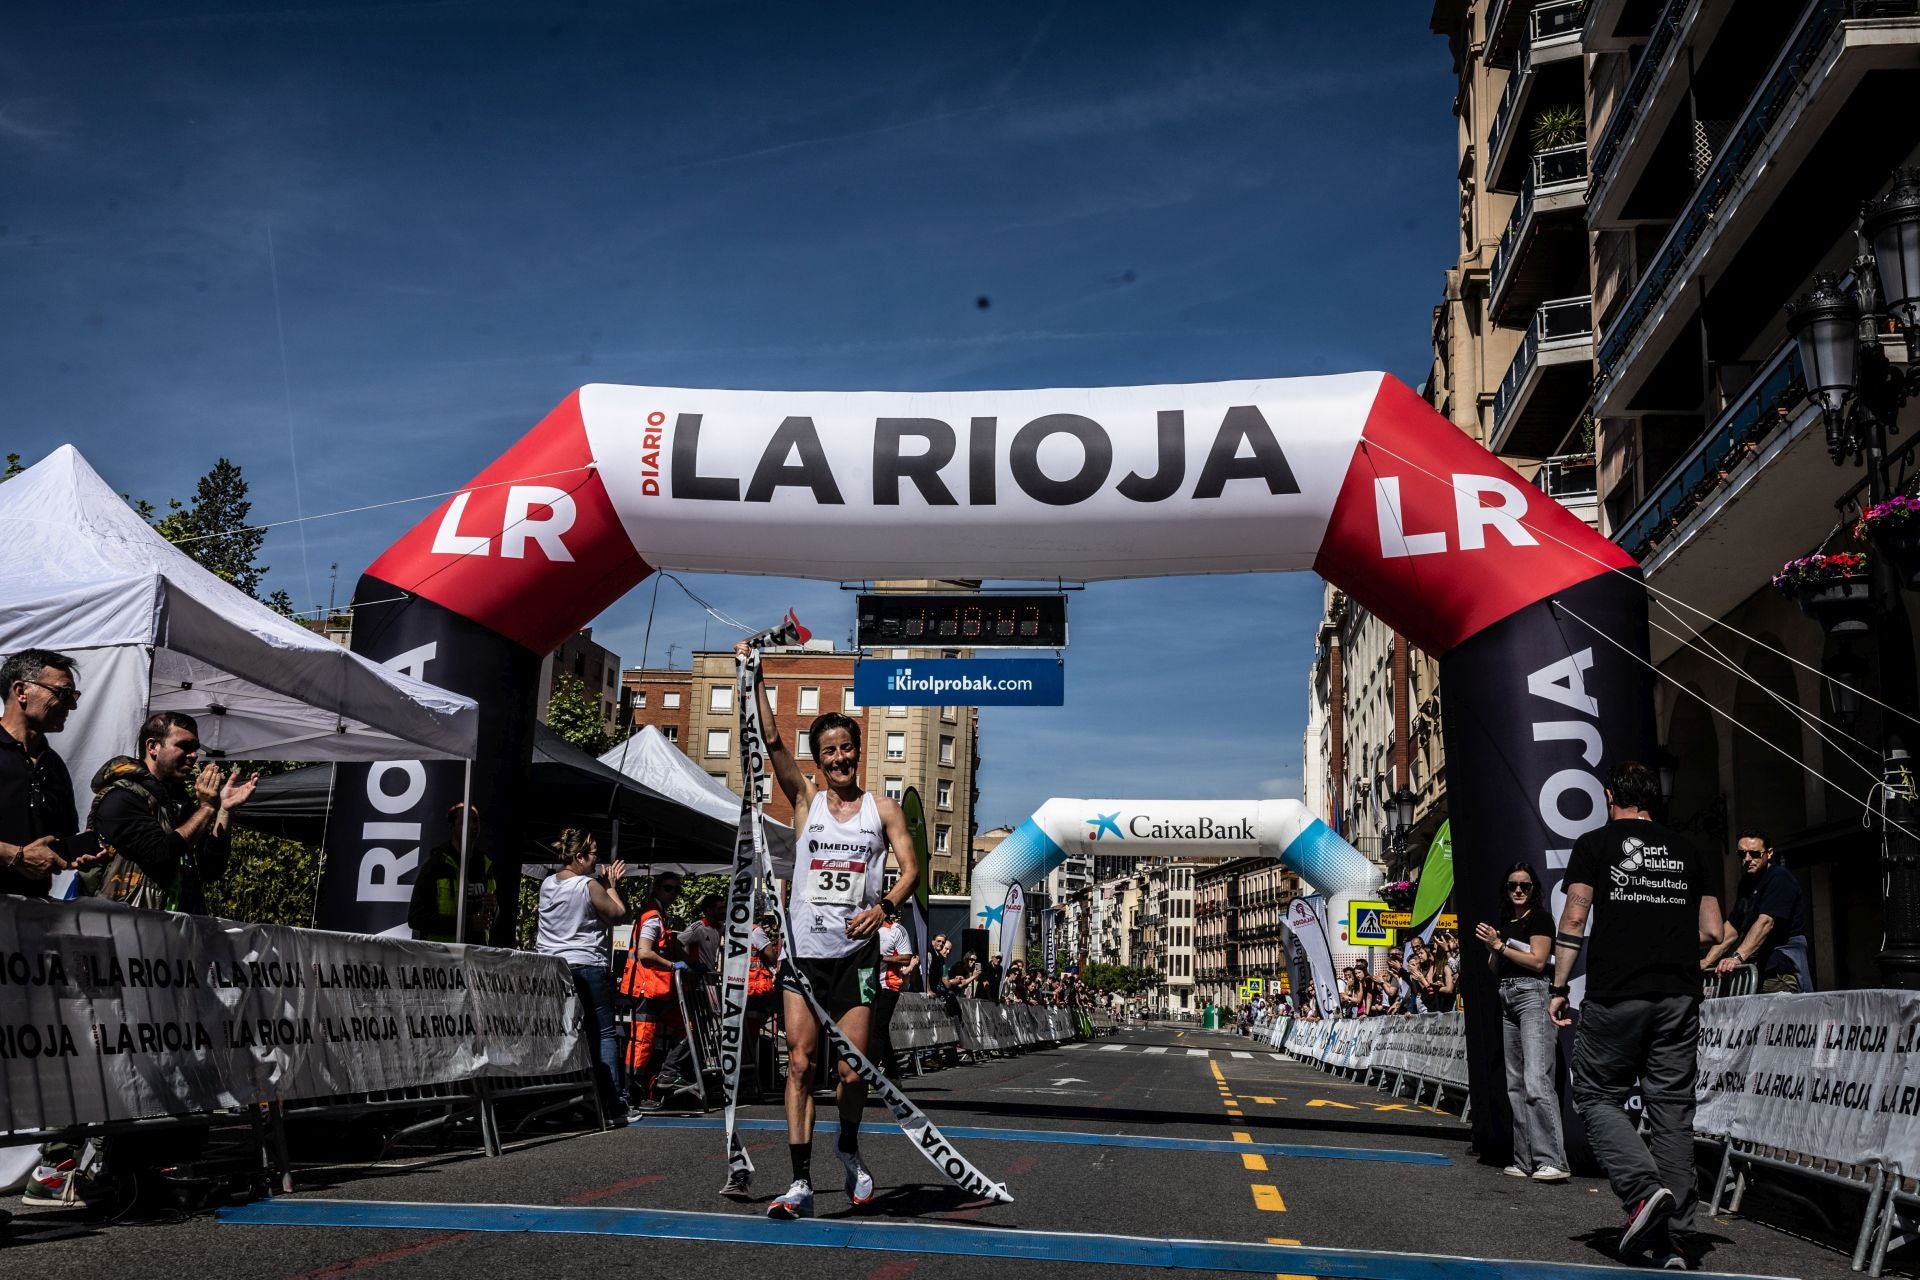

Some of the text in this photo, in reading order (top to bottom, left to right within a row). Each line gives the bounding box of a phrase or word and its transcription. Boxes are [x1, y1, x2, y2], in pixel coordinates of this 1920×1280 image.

[642, 411, 666, 496] DIARIO
[672, 405, 1302, 506] LA RIOJA
[431, 486, 577, 562] LR
[1374, 473, 1540, 558] LR
[896, 671, 1032, 694] Kirolprobak.com
[1129, 815, 1256, 840] CaixaBank
[820, 842, 873, 854] IMEDUSA
[818, 871, 851, 892] 35
[1630, 876, 1688, 890] TuResultado
[1614, 891, 1686, 904] Kirolprobak.com
[728, 876, 751, 959] RIOJA
[91, 955, 126, 987] LA
[128, 957, 200, 988] RIOJA
[214, 961, 248, 988] LA
[249, 961, 305, 988] RIOJA
[318, 963, 391, 990] LA RIOJA
[401, 966, 467, 990] LA RIOJA
[724, 983, 744, 1019] LA
[99, 1022, 213, 1055] LA RIOJA
[257, 1018, 314, 1047] RIOJA
[326, 1016, 400, 1043] LA RIOJA
[409, 1014, 476, 1039] LA RIOJA
[1767, 1023, 1785, 1046] LA
[1784, 1023, 1818, 1048] RIOJA
[1825, 1024, 1888, 1053] LA RIOJA
[1757, 1072, 1772, 1096] LA
[1771, 1073, 1805, 1100] RIOJA
[1812, 1077, 1872, 1110] LA RIOJA
